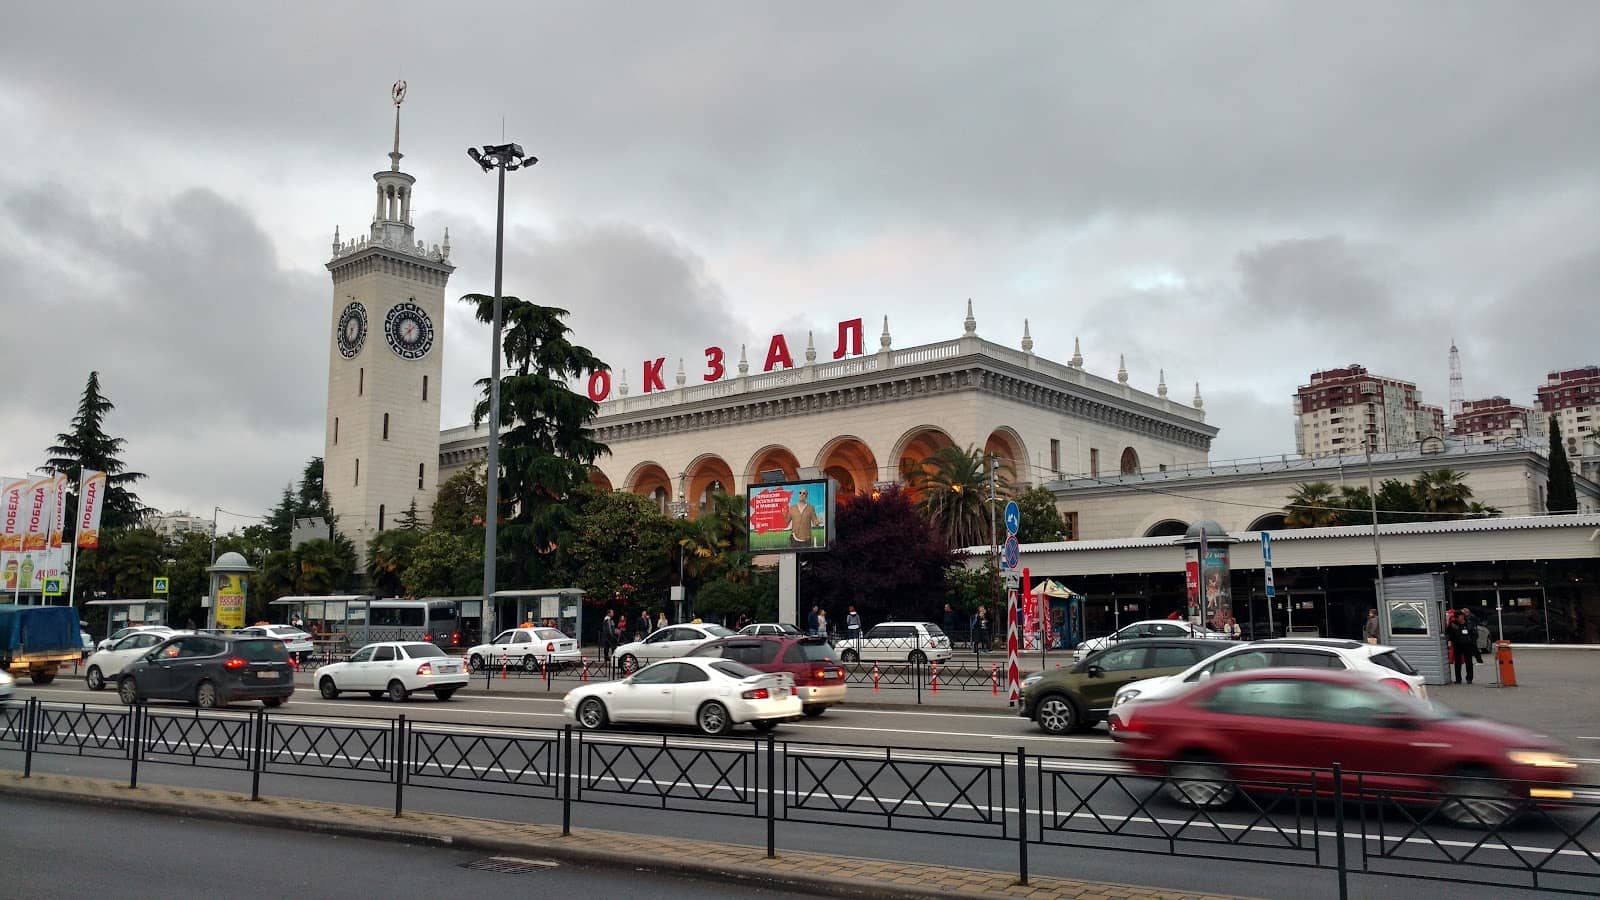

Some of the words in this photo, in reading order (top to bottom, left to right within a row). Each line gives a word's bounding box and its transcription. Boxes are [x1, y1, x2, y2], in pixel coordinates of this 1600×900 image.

[5, 488, 20, 534] ПОБЕДА
[29, 487, 45, 533] ПОБЕДА
[82, 482, 96, 529] ПОБЕДА
